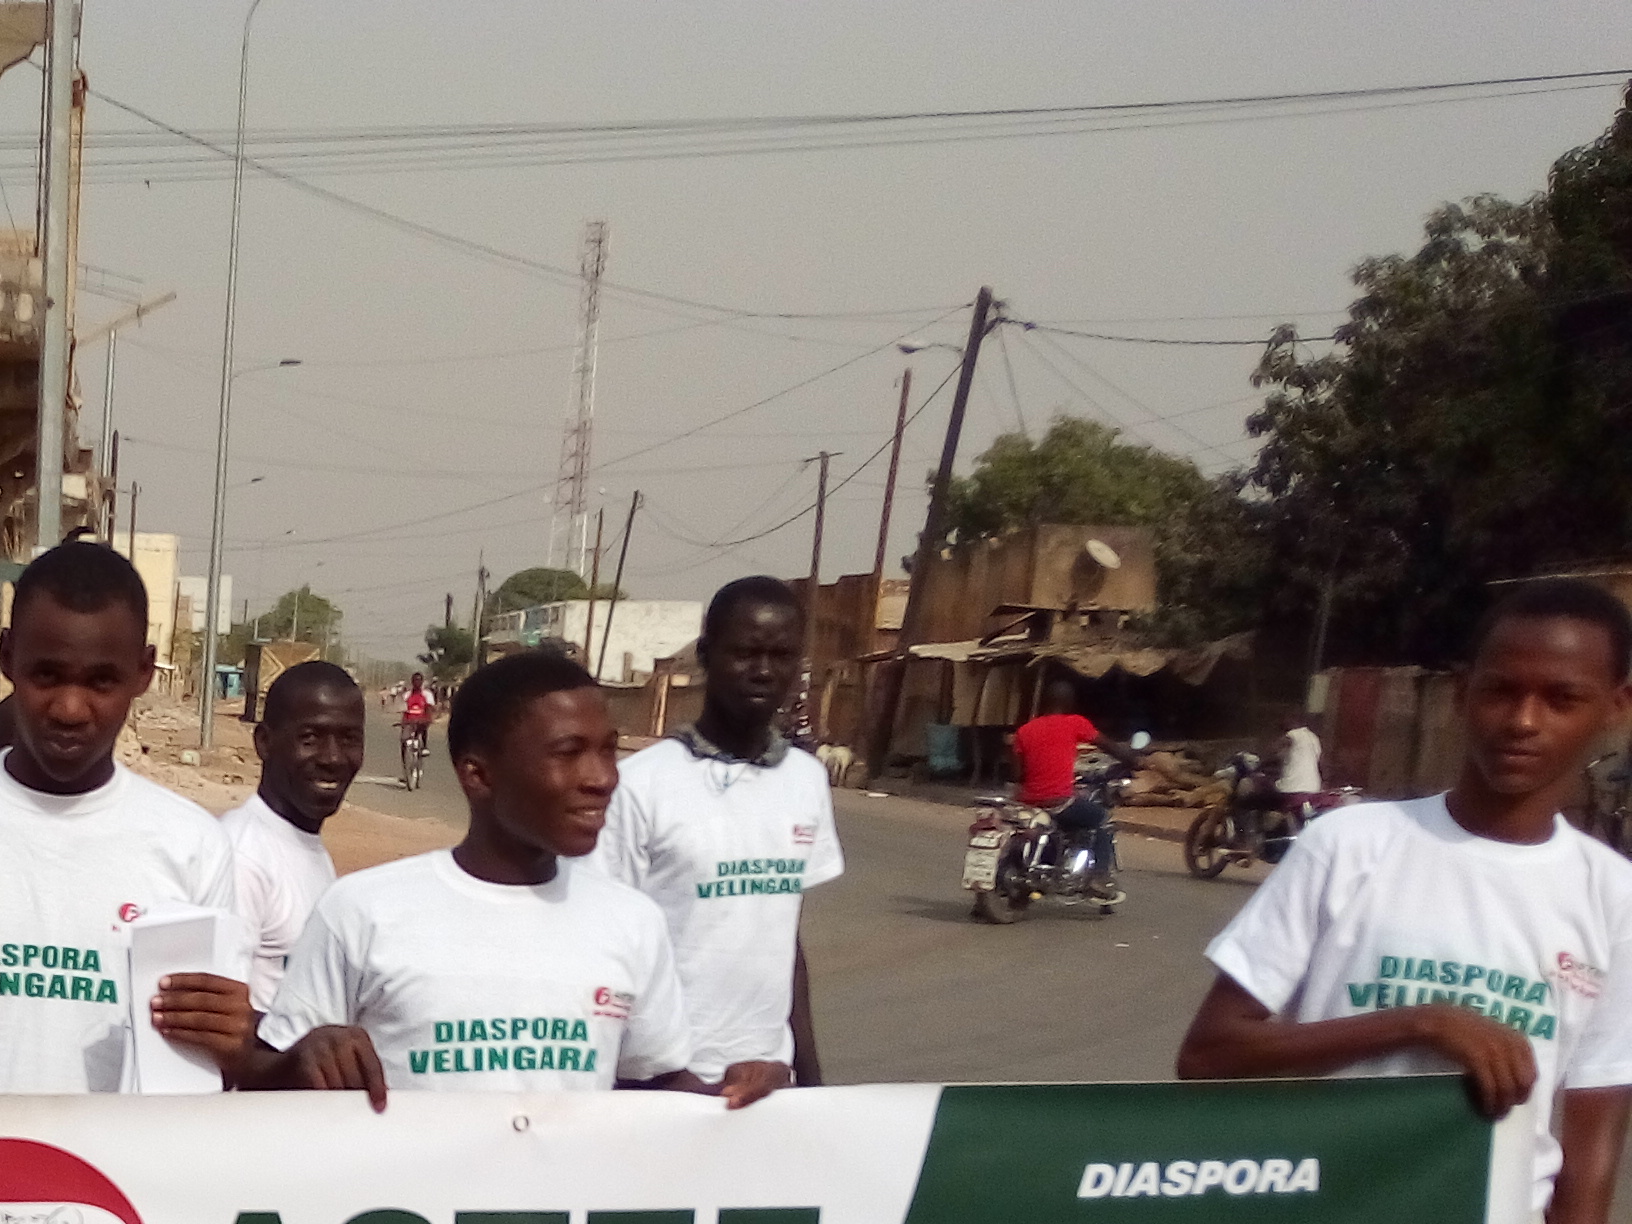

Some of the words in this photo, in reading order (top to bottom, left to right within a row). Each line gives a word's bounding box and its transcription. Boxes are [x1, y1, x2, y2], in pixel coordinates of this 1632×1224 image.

[1380, 956, 1550, 1006] DIASPORA
[434, 1017, 588, 1043] DIASPORA
[409, 1046, 598, 1074] VELINGARA
[1077, 1158, 1320, 1199] DIASPORA
